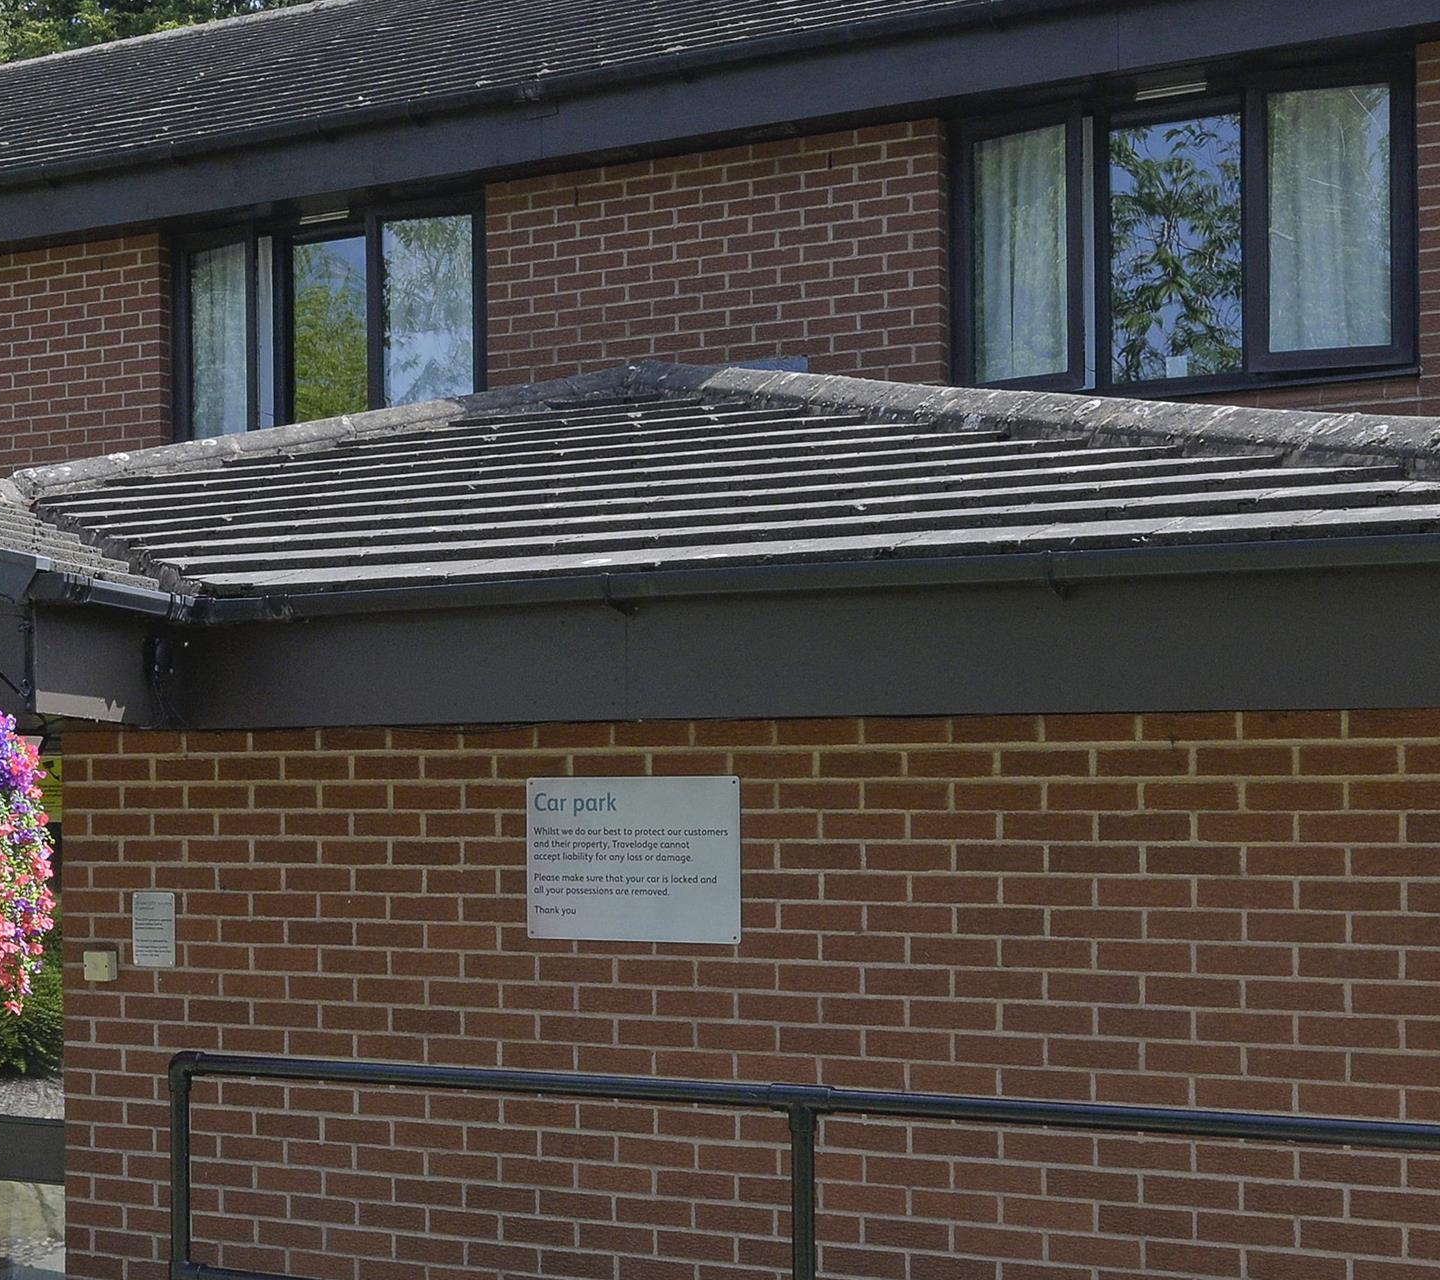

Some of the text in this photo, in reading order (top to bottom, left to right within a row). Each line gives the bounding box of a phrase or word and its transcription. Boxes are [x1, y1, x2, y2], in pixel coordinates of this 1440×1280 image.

[534, 792, 617, 817] Car park
[533, 826, 729, 838] Whilst we do our best to protect our customers
[533, 839, 690, 851] and their property, Travelodge cannot
[533, 851, 694, 864] accept liability for any loss or damage.
[533, 872, 718, 885] Please make sure that your car is locked and
[533, 885, 670, 896] all your possessions are removed.
[533, 905, 577, 916] Thank you
